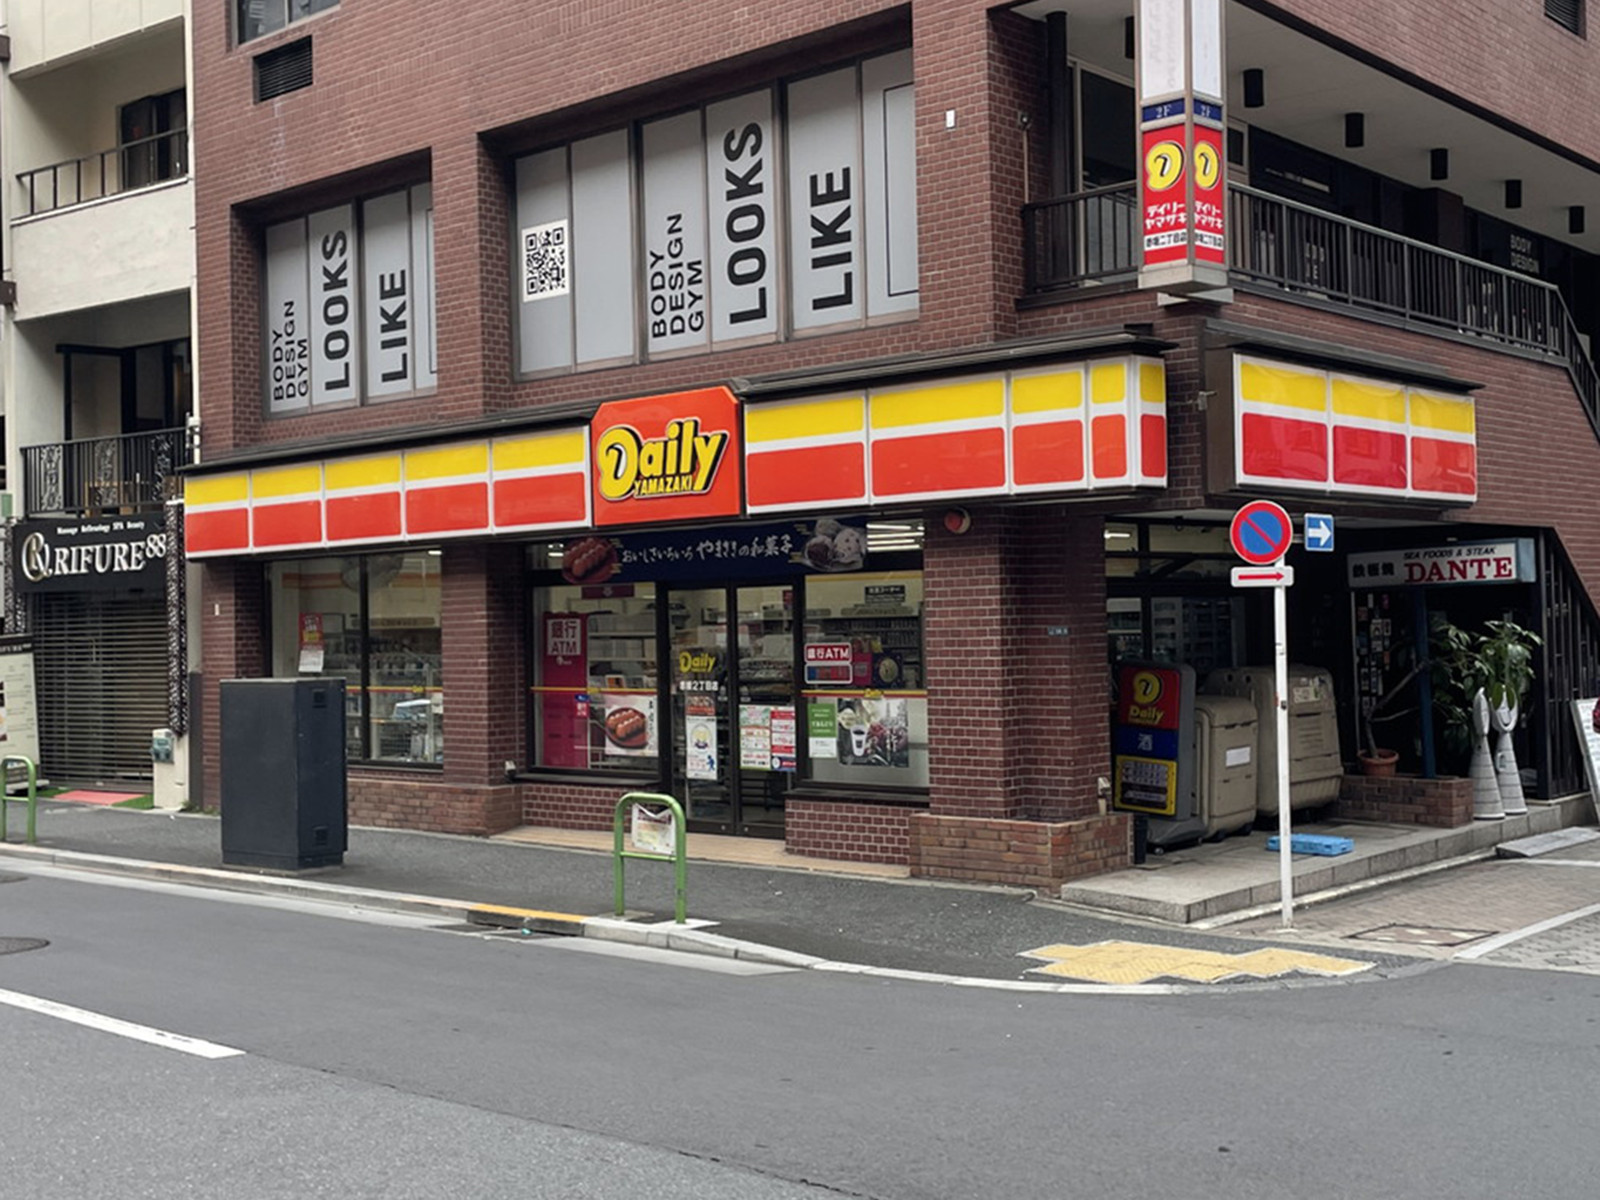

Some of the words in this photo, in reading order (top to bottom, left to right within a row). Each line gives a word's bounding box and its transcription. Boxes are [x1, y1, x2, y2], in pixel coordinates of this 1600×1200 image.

[1156, 104, 1172, 118] 2F
[723, 121, 768, 325] LOOKS
[809, 166, 854, 311] LIKE
[1145, 212, 1187, 230] ヤマザキ
[1147, 201, 1185, 217] デイリー
[649, 250, 669, 338] BODY
[666, 213, 687, 335] DESIGN
[687, 259, 705, 333] GYM
[322, 230, 350, 391] LOOKS
[379, 269, 408, 383] LIKE
[272, 329, 284, 401] BODY
[283, 301, 297, 399] DESIGN
[297, 338, 309, 397] GYM
[598, 417, 729, 500] Daily
[635, 475, 693, 497] YAMAZAKI
[1404, 552, 1419, 560] SEA
[1423, 549, 1453, 559] FOODS
[1466, 546, 1497, 556] STEAK
[1404, 557, 1513, 584] DANTE
[552, 641, 577, 654] ATM
[679, 651, 716, 673] Daily
[1129, 705, 1165, 725] Daily
